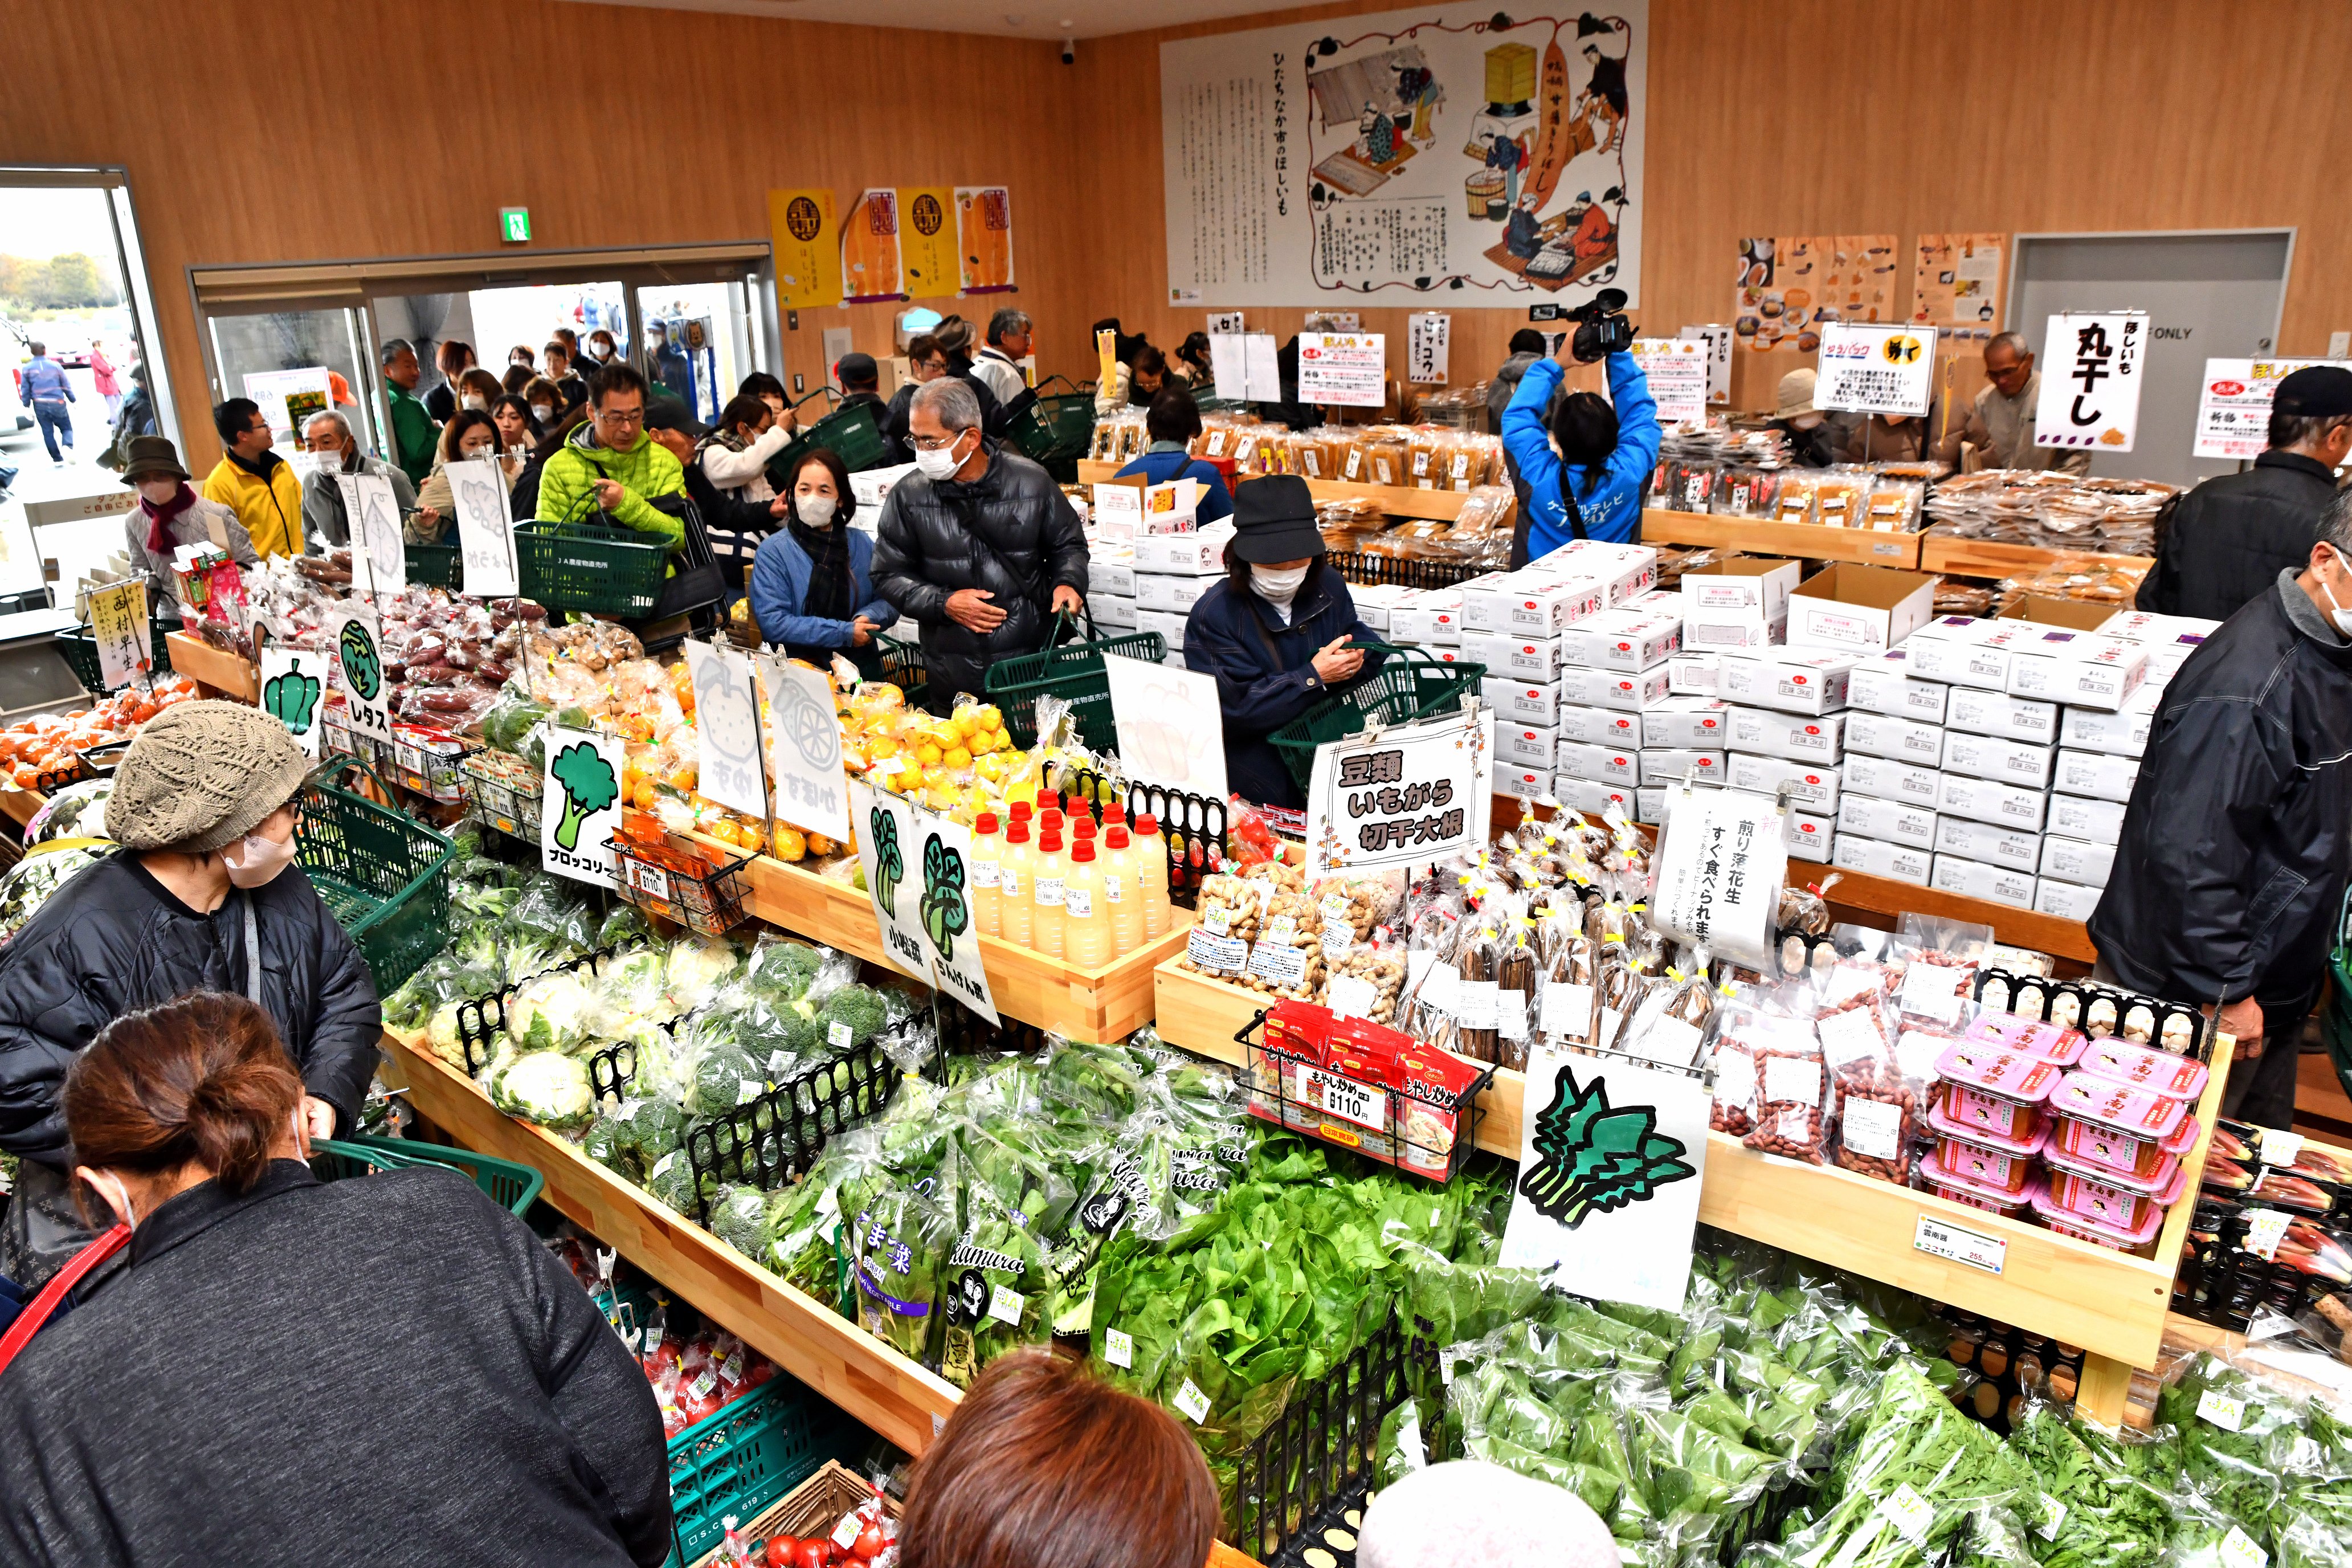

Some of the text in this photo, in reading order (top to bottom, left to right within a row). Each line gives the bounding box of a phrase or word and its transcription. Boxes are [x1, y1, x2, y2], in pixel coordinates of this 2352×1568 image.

[1272, 51, 1289, 217] ひたちなか市のほしいも
[1323, 336, 1357, 349] ほしいも
[2118, 321, 2139, 375] ほしいも
[2154, 328, 2192, 340] ONLY
[2070, 322, 2113, 426] 丸干し
[1547, 493, 1623, 515] ケールテレビ
[113, 595, 133, 672] 西村早生
[1072, 691, 1109, 705] 産物直売所
[350, 700, 387, 733] レタス
[1338, 750, 1403, 788] 豆類
[1348, 779, 1453, 818] いもがら
[1359, 808, 1464, 852] 切干大根
[1761, 815, 1779, 834] 新
[549, 849, 614, 873] ブロッコリー
[1724, 819, 1755, 905] 煎り落花生
[646, 877, 659, 892] 110
[1696, 827, 1726, 948] すぐ食べられます。
[889, 925, 924, 967] 小松菜
[935, 957, 986, 1004] ちんげん菜
[1312, 1071, 1369, 1101] もやし炒め の素
[1337, 1095, 1361, 1117] 110
[1323, 1126, 1355, 1144] 日本食研
[1969, 1252, 1982, 1261] 255
[866, 1282, 902, 1312] VEGETABLE
[742, 1496, 758, 1510] 619
[2040, 1528, 2053, 1539] ¥160
